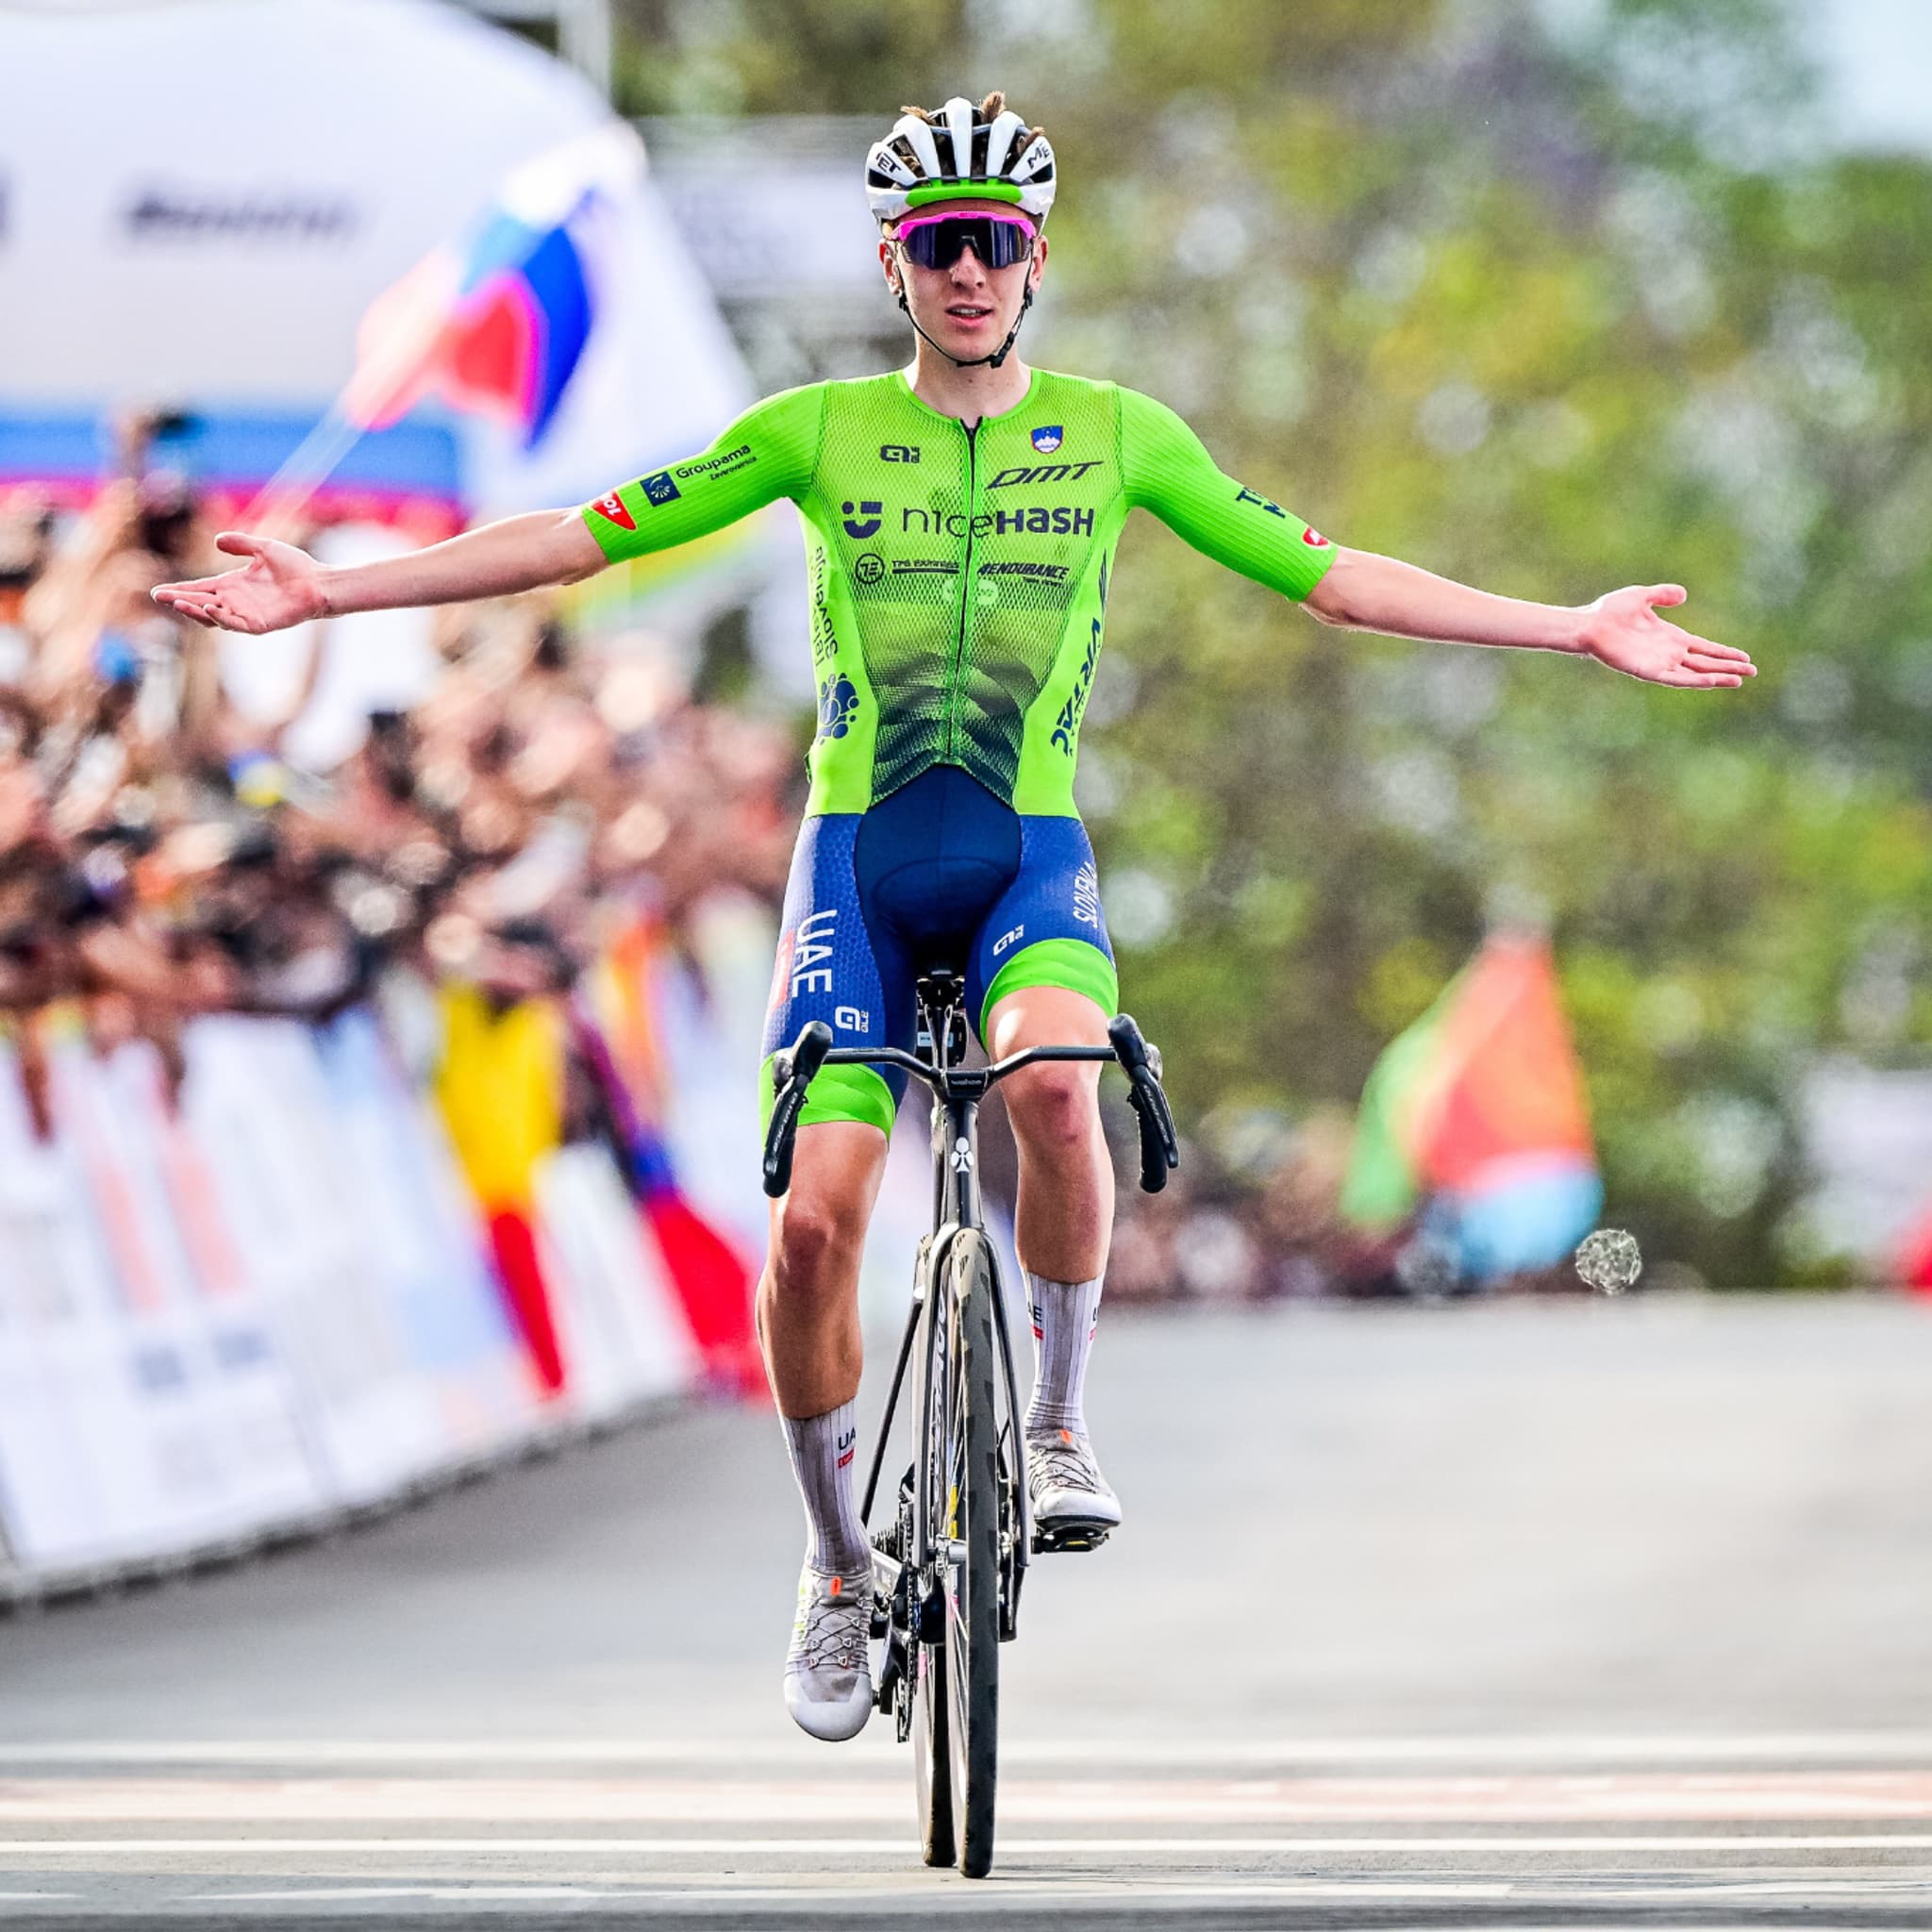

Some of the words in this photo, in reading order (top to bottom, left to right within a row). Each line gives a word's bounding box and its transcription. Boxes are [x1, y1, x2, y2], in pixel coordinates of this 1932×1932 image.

[876, 151, 902, 174] ET
[1027, 144, 1050, 170] ME
[675, 444, 751, 479] Groupama
[985, 461, 1104, 490] DMT
[791, 909, 838, 998] UAE
[838, 1426, 857, 1451] UA
